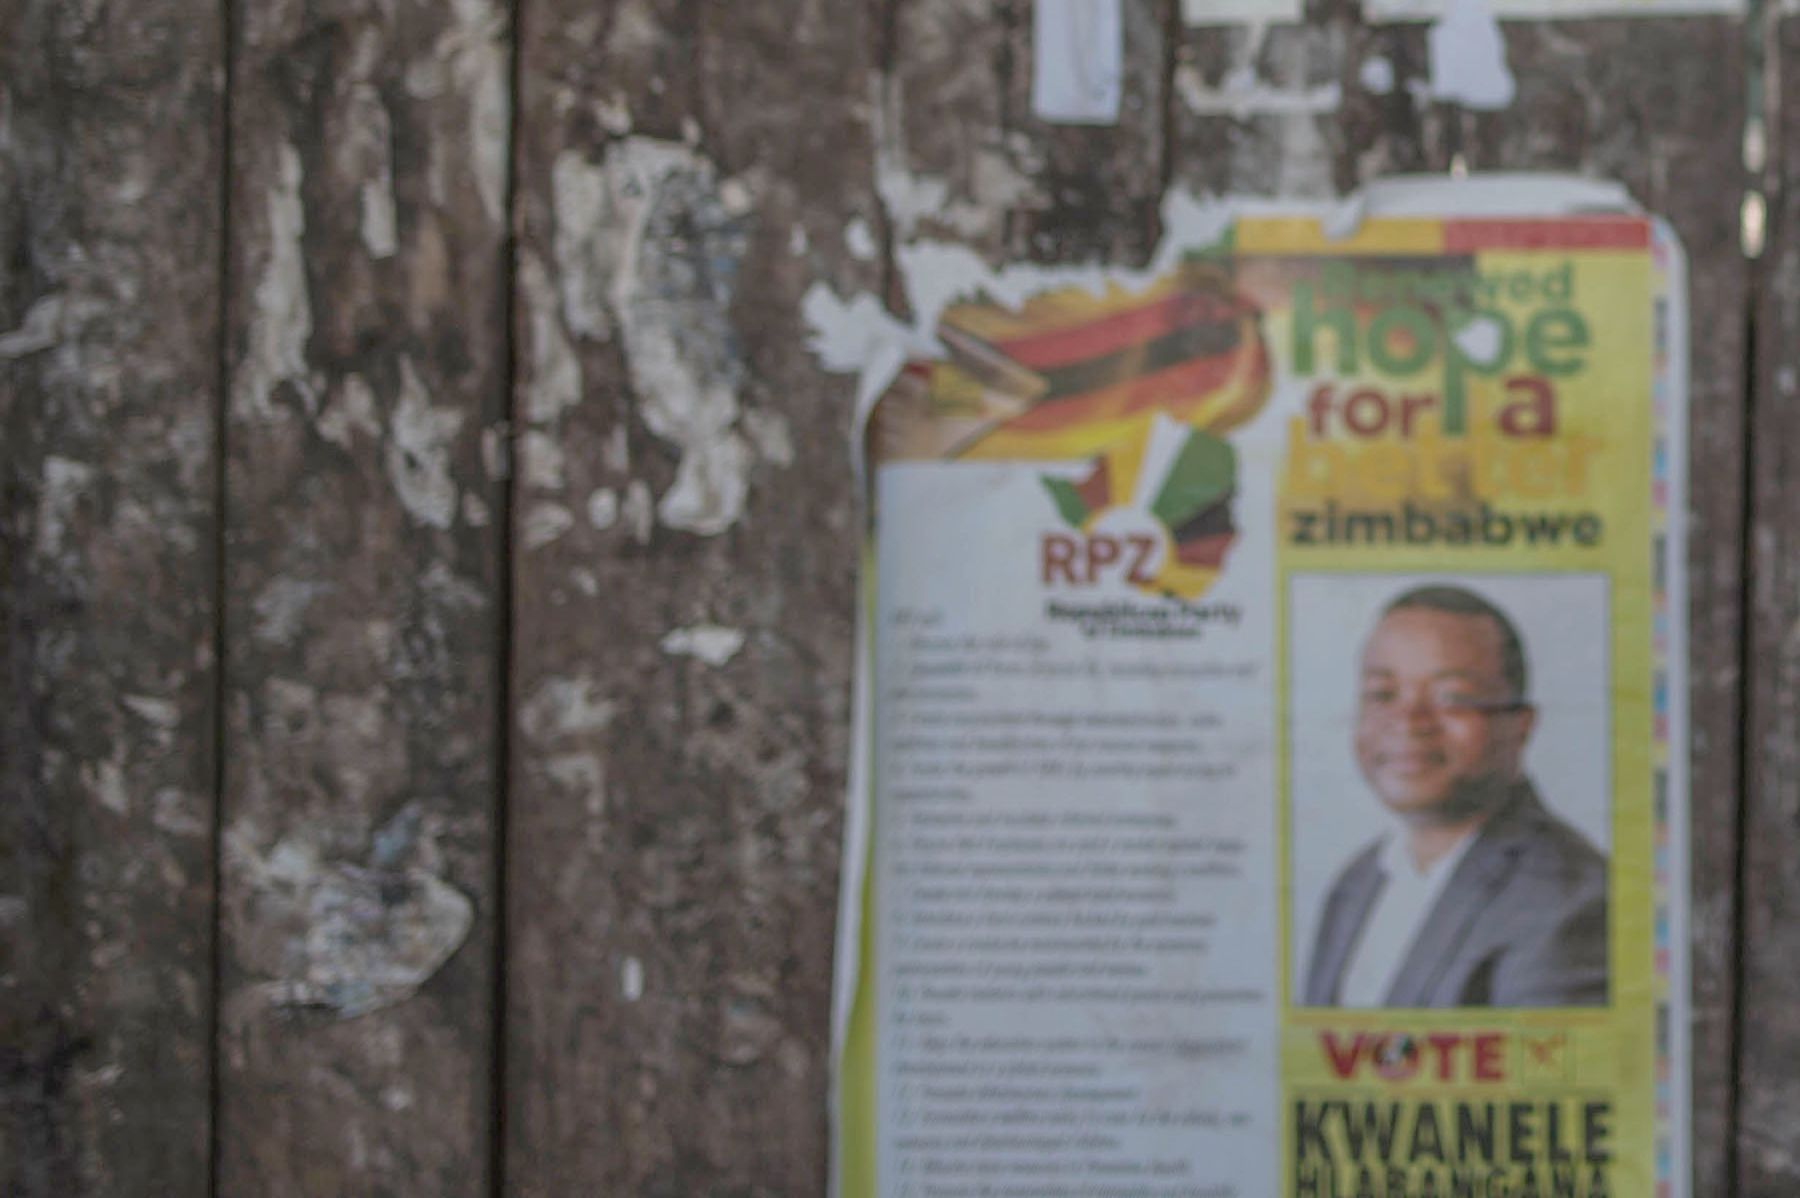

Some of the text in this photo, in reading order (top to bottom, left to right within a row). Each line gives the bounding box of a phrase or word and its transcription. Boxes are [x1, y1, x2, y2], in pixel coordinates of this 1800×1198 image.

[1290, 279, 1590, 437] hope
[1308, 375, 1559, 439] for a
[1289, 500, 1604, 547] zimbabwe
[1040, 532, 1159, 587] RPZ
[1317, 1030, 1508, 1083] VOTE
[1293, 1099, 1615, 1164] KWANELE
